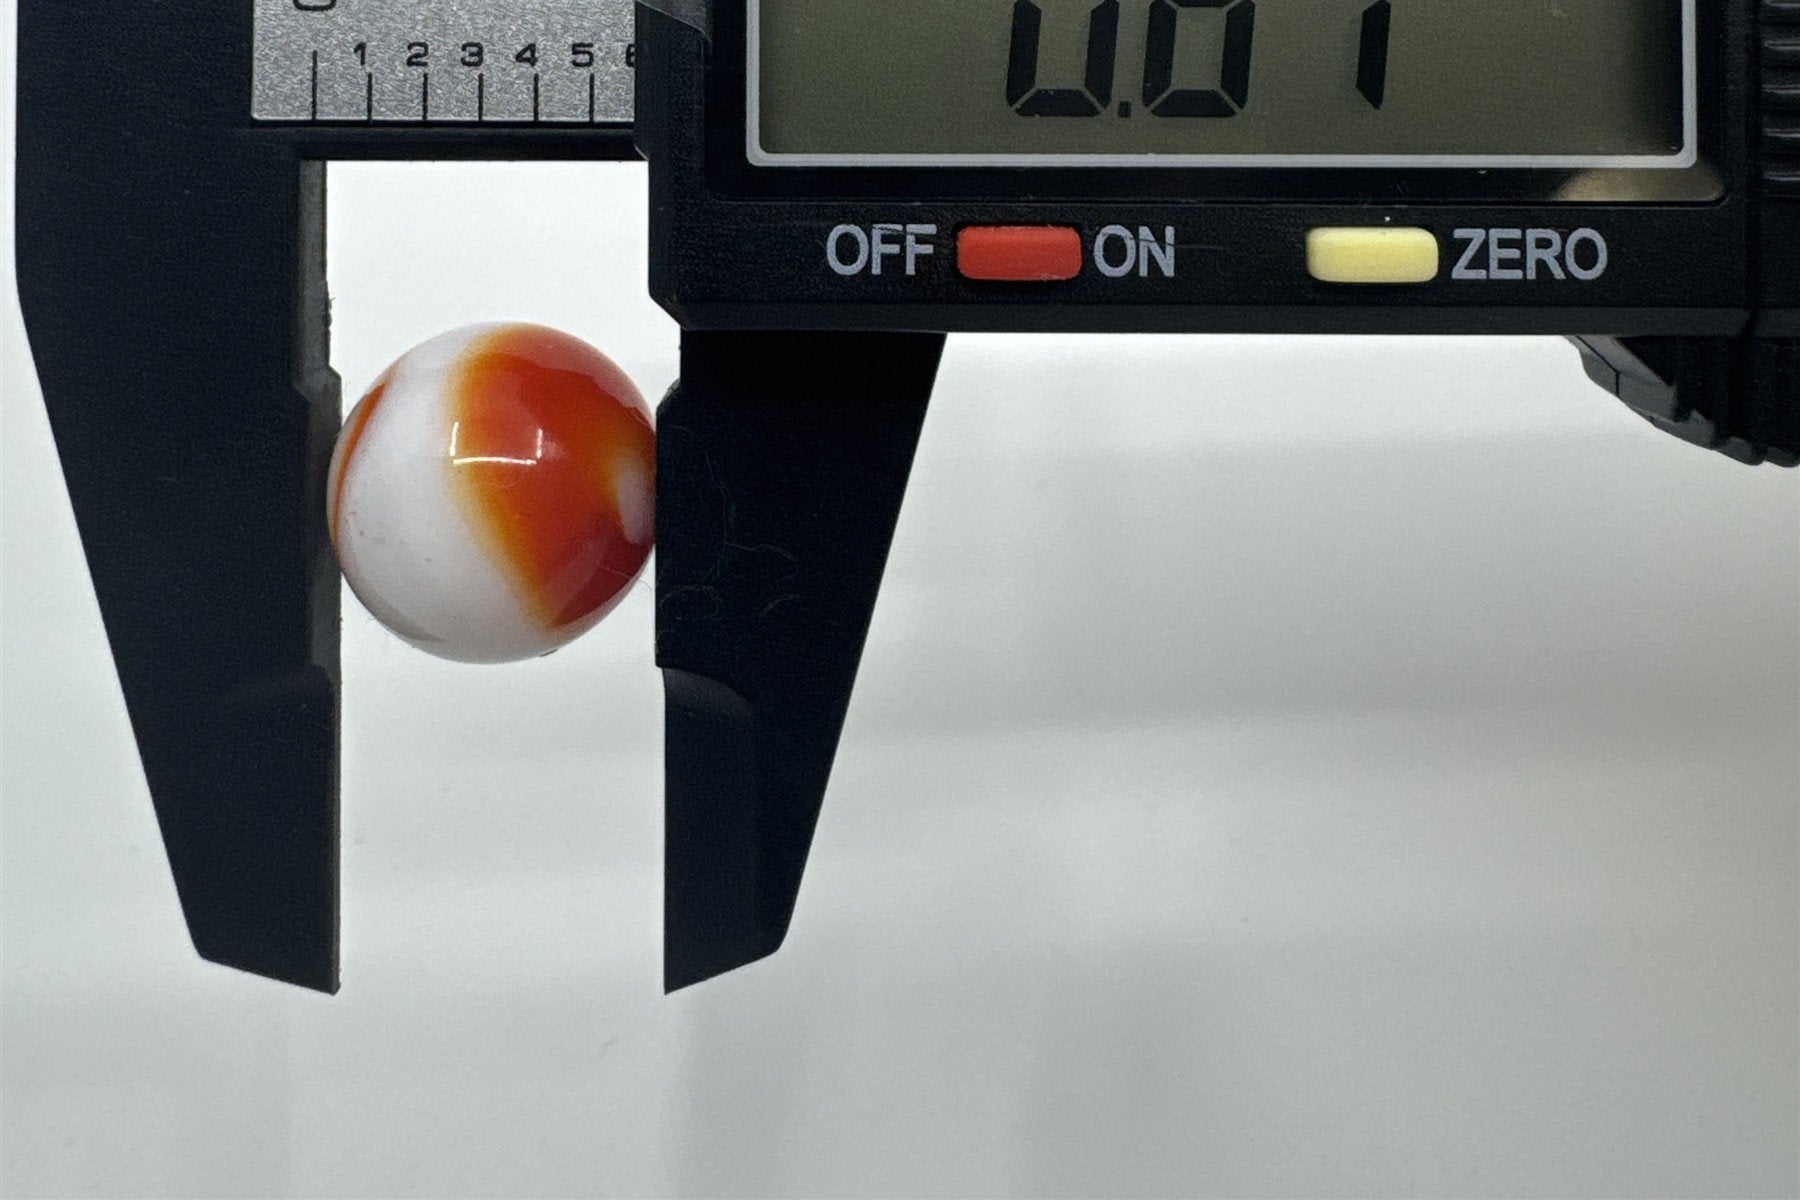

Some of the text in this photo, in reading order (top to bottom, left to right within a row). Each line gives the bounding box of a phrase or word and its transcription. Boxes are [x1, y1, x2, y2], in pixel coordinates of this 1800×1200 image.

[353, 41, 367, 67] 1
[406, 41, 430, 67] 2
[460, 41, 485, 67] 3
[515, 42, 540, 67] 4
[571, 42, 595, 67] 5
[825, 223, 1176, 278] OFF ON
[1451, 227, 1610, 281] ZERO
